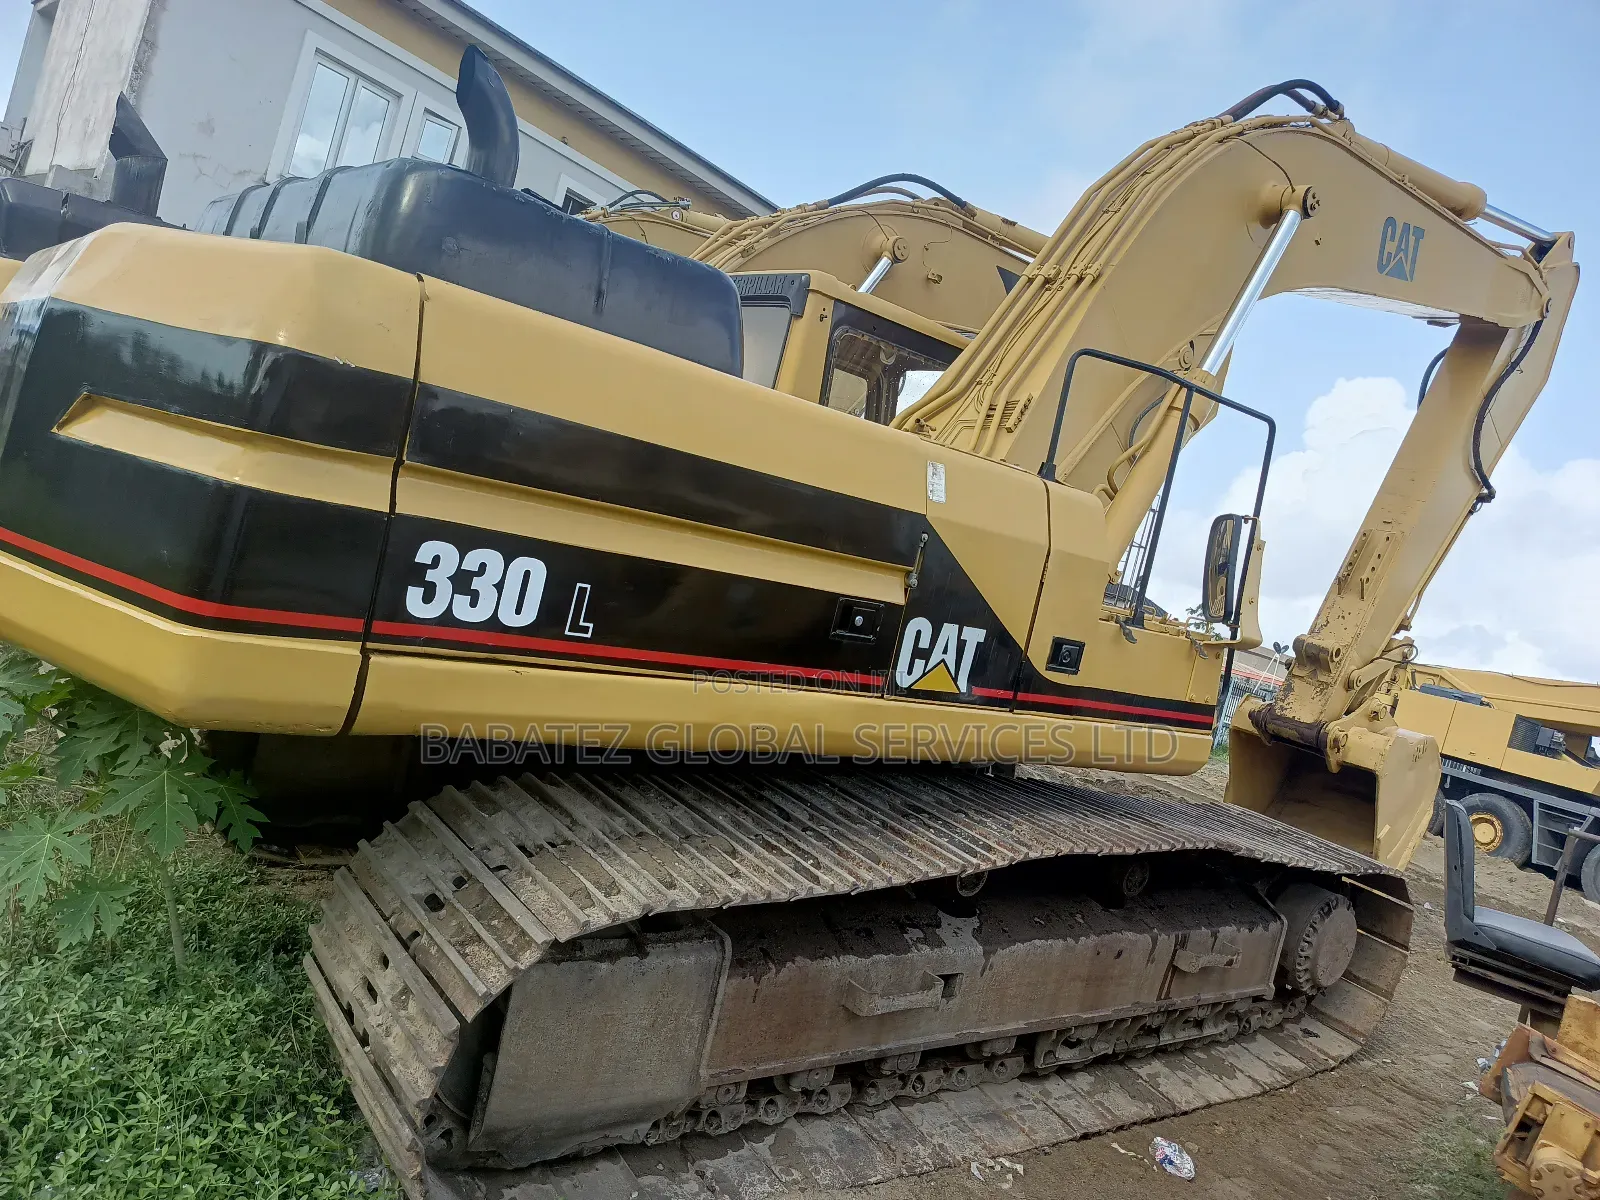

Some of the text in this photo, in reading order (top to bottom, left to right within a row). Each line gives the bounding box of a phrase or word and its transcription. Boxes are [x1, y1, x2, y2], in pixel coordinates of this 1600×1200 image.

[1377, 216, 1425, 282] CAT
[734, 275, 787, 295] ERPILLAR
[406, 541, 594, 638] 330 L
[896, 617, 987, 693] CAT
